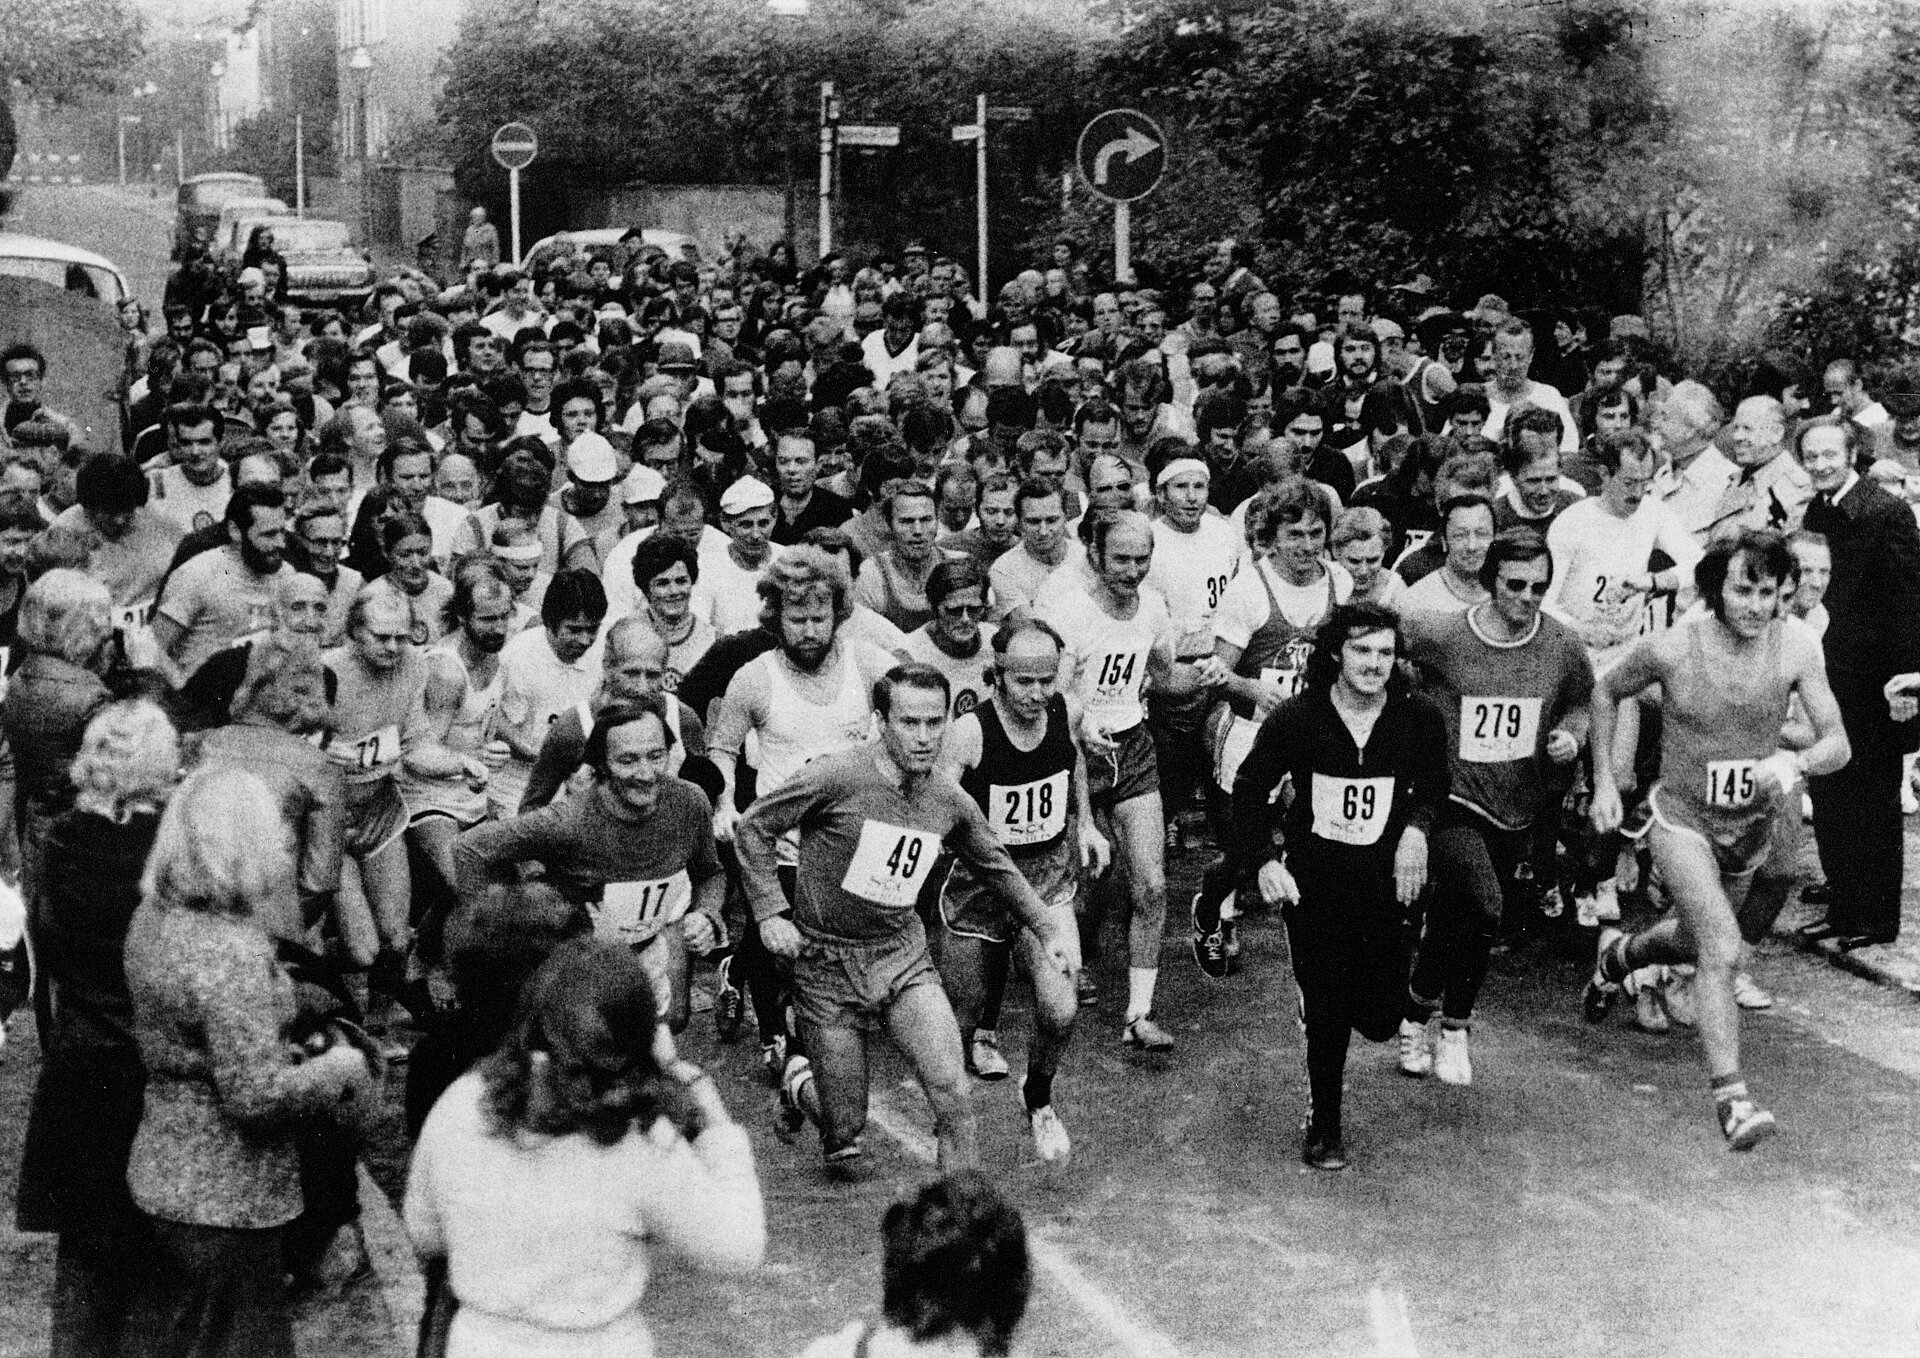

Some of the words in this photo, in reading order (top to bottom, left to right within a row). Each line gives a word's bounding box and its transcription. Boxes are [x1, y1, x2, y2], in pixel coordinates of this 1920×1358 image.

[1098, 653, 1136, 685] 154
[1474, 704, 1521, 738] 279
[1005, 782, 1052, 824] 218
[1343, 785, 1375, 820] 69
[1712, 767, 1753, 803] 145
[886, 834, 922, 878] 49
[639, 882, 670, 920] 17
